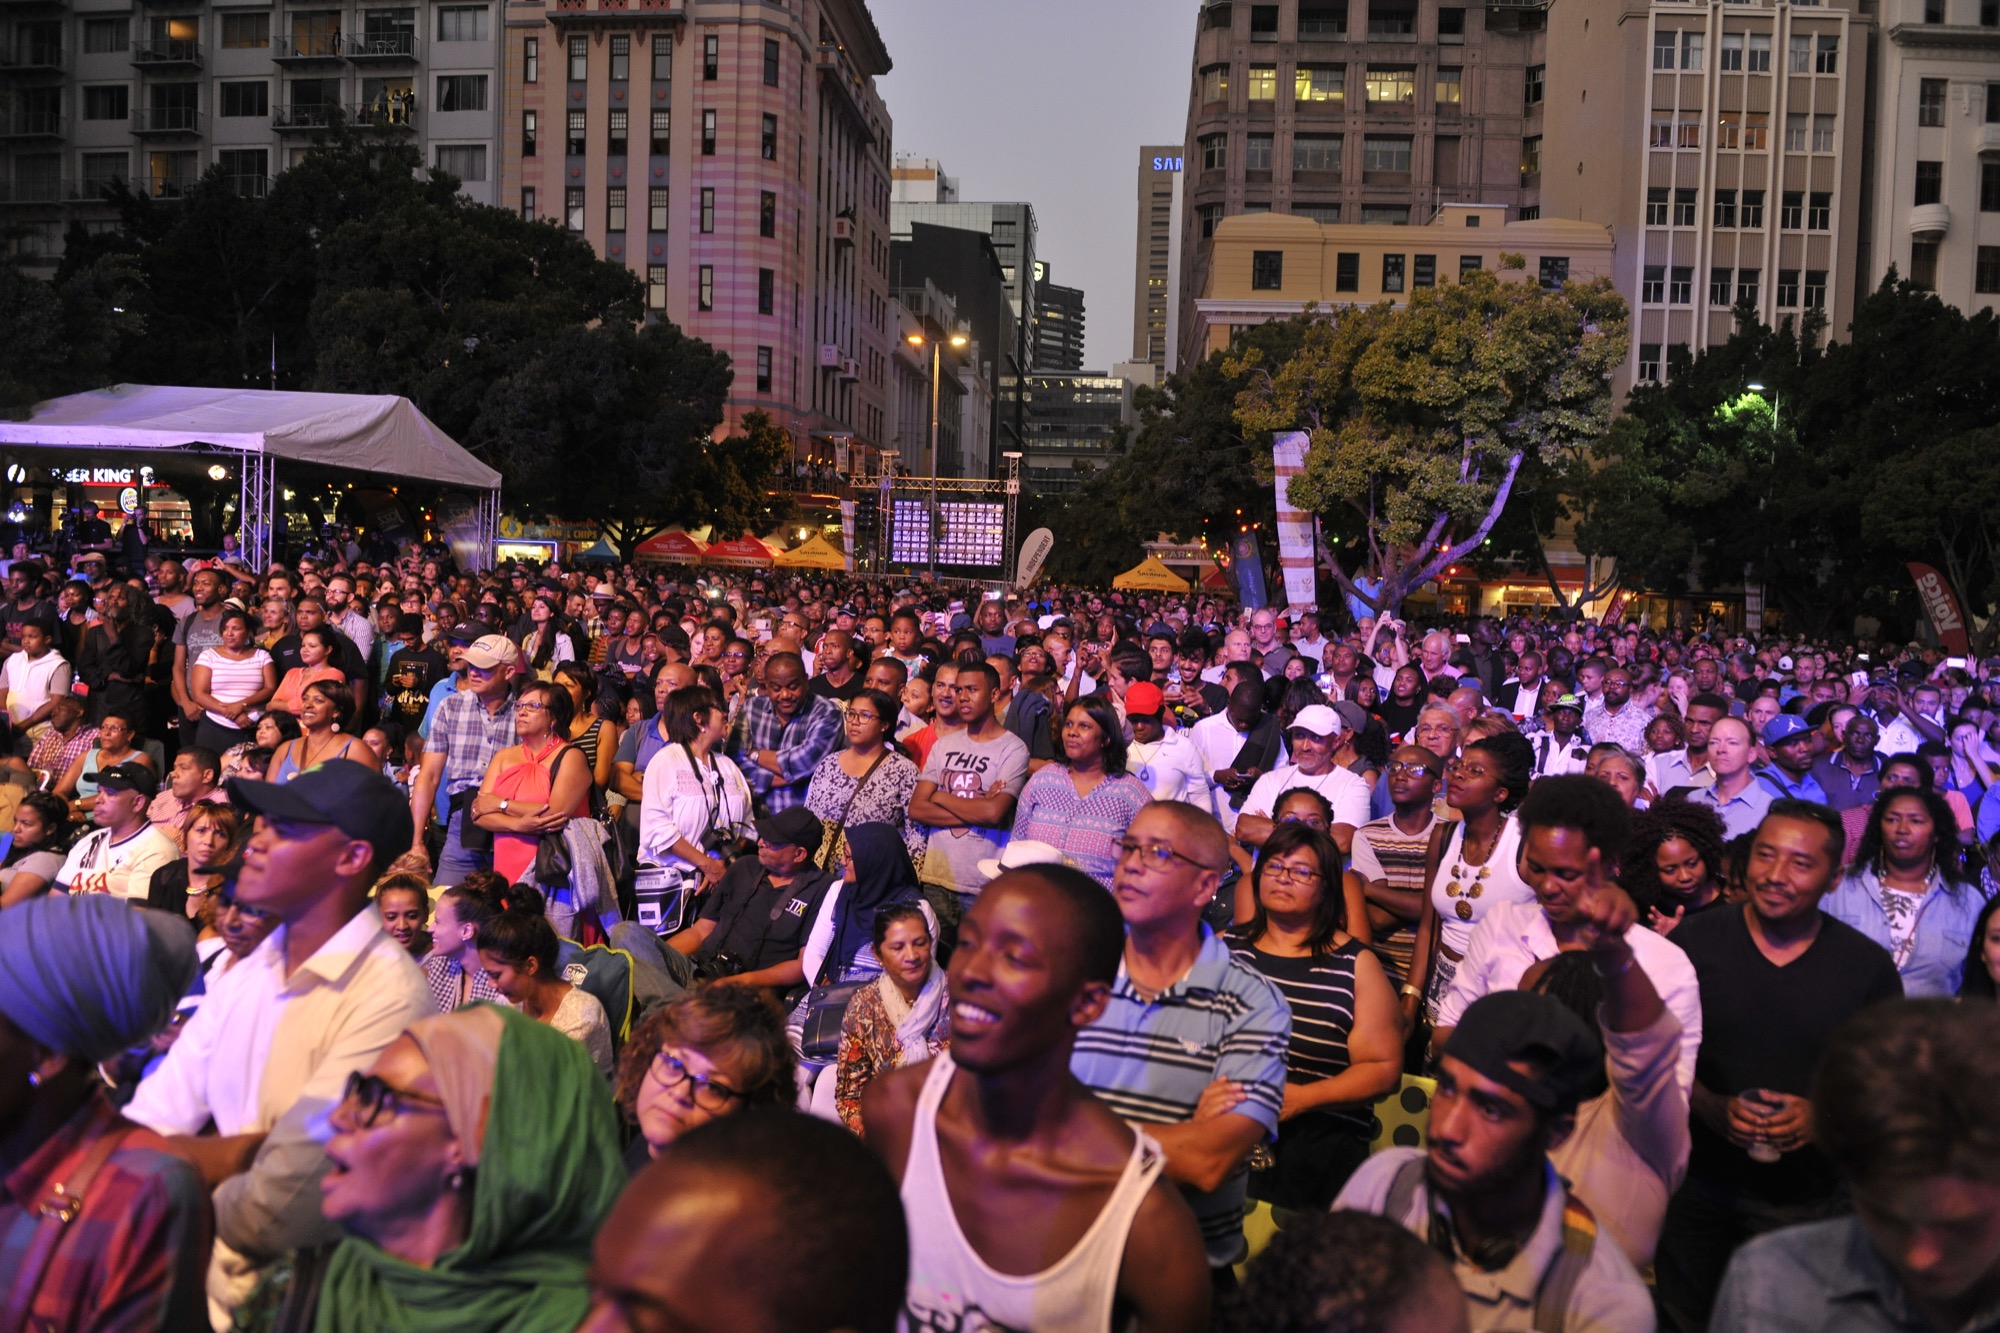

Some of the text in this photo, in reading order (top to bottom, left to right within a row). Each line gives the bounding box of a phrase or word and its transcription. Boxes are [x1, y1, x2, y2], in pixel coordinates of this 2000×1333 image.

[93, 468, 132, 483] KING
[544, 529, 562, 538] FISH
[573, 529, 597, 539] CHIPS
[1026, 534, 1051, 572] INDEPENDENT
[945, 751, 990, 774] THIS
[953, 773, 974, 789] AF
